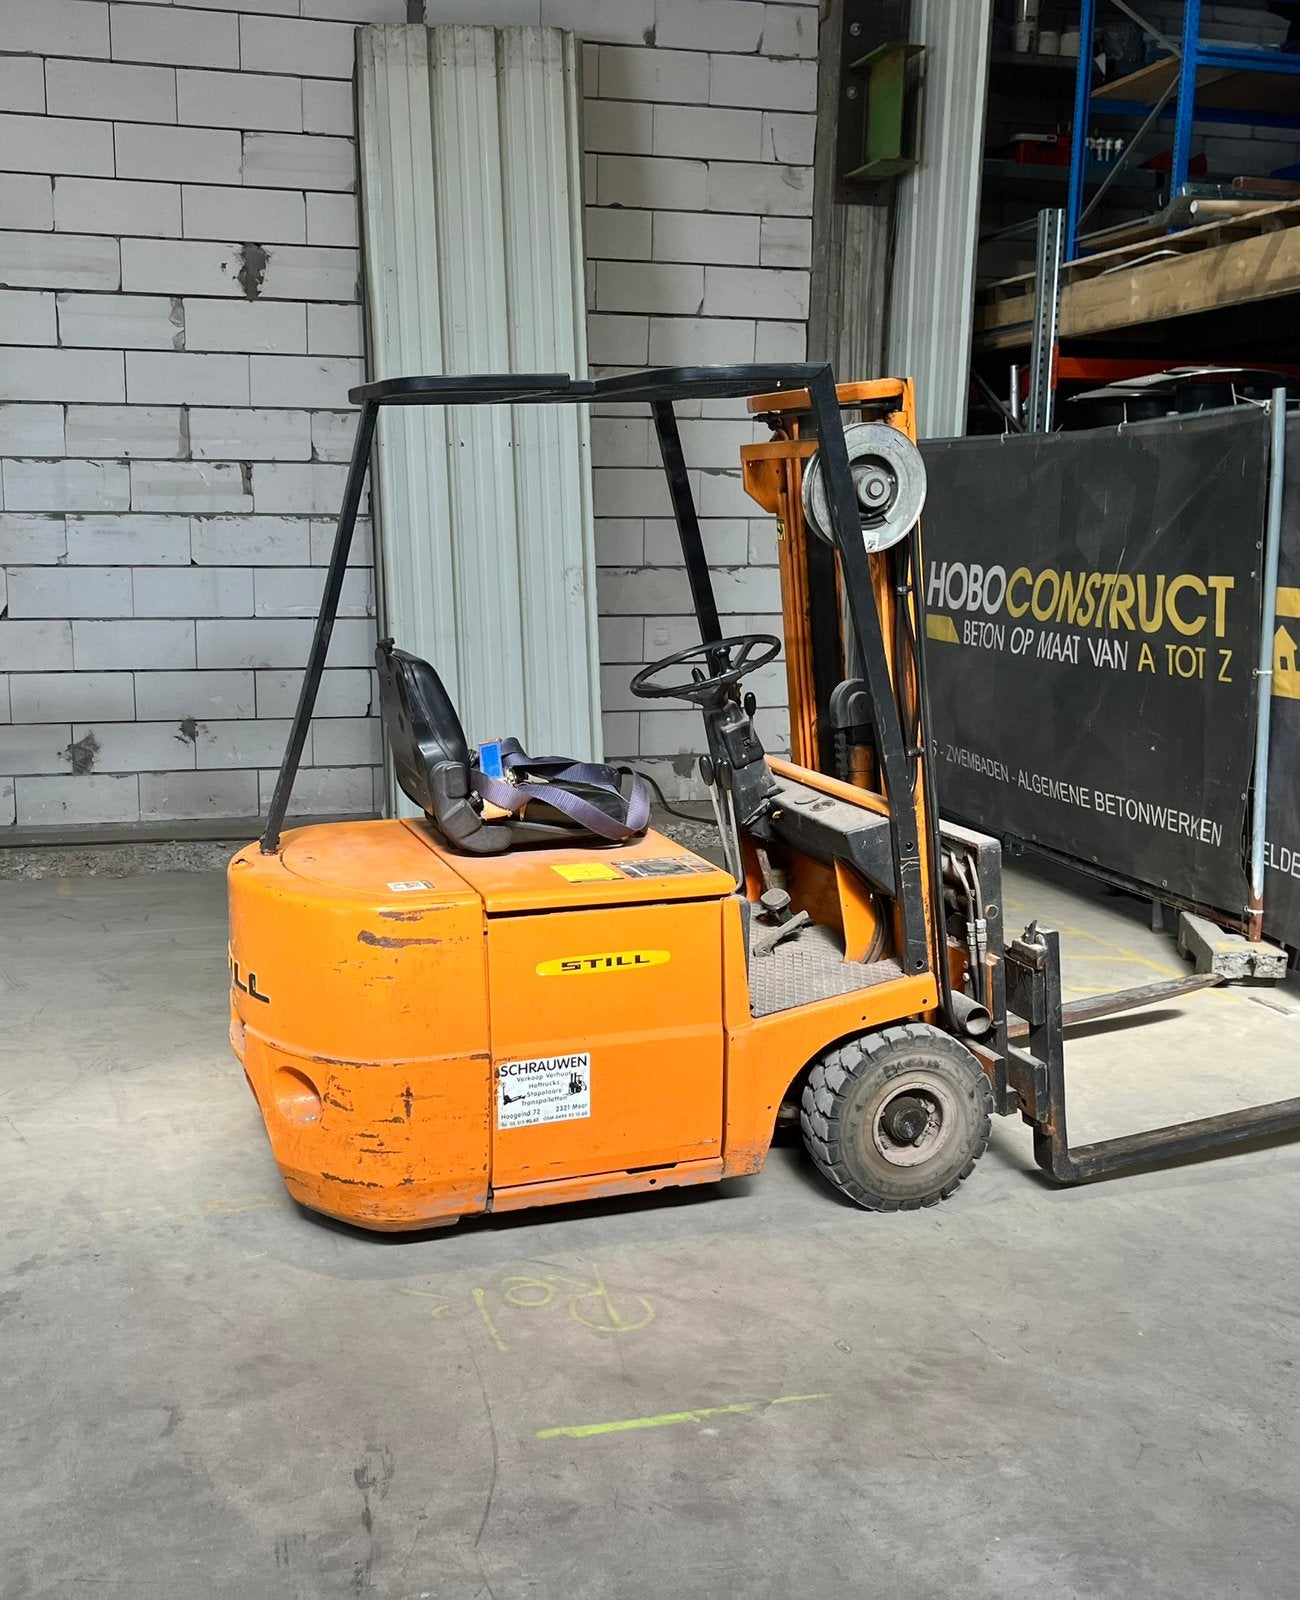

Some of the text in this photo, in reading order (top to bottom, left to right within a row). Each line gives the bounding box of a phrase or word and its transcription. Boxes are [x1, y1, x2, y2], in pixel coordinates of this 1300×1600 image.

[927, 561, 1235, 637] HOBOCONSTRUCT
[963, 620, 1232, 683] BETON OP MAAT VAN A TOT Z
[946, 744, 1010, 783] ZWEMBADEN
[1018, 769, 1091, 809] ALGEMENE
[1094, 790, 1223, 847] BETONWERKEN
[561, 954, 650, 971] STILL
[500, 1055, 587, 1077] SCHRAUWEN
[516, 1071, 571, 1082] Verkoop Verhuur
[528, 1081, 560, 1089] Heftrucks
